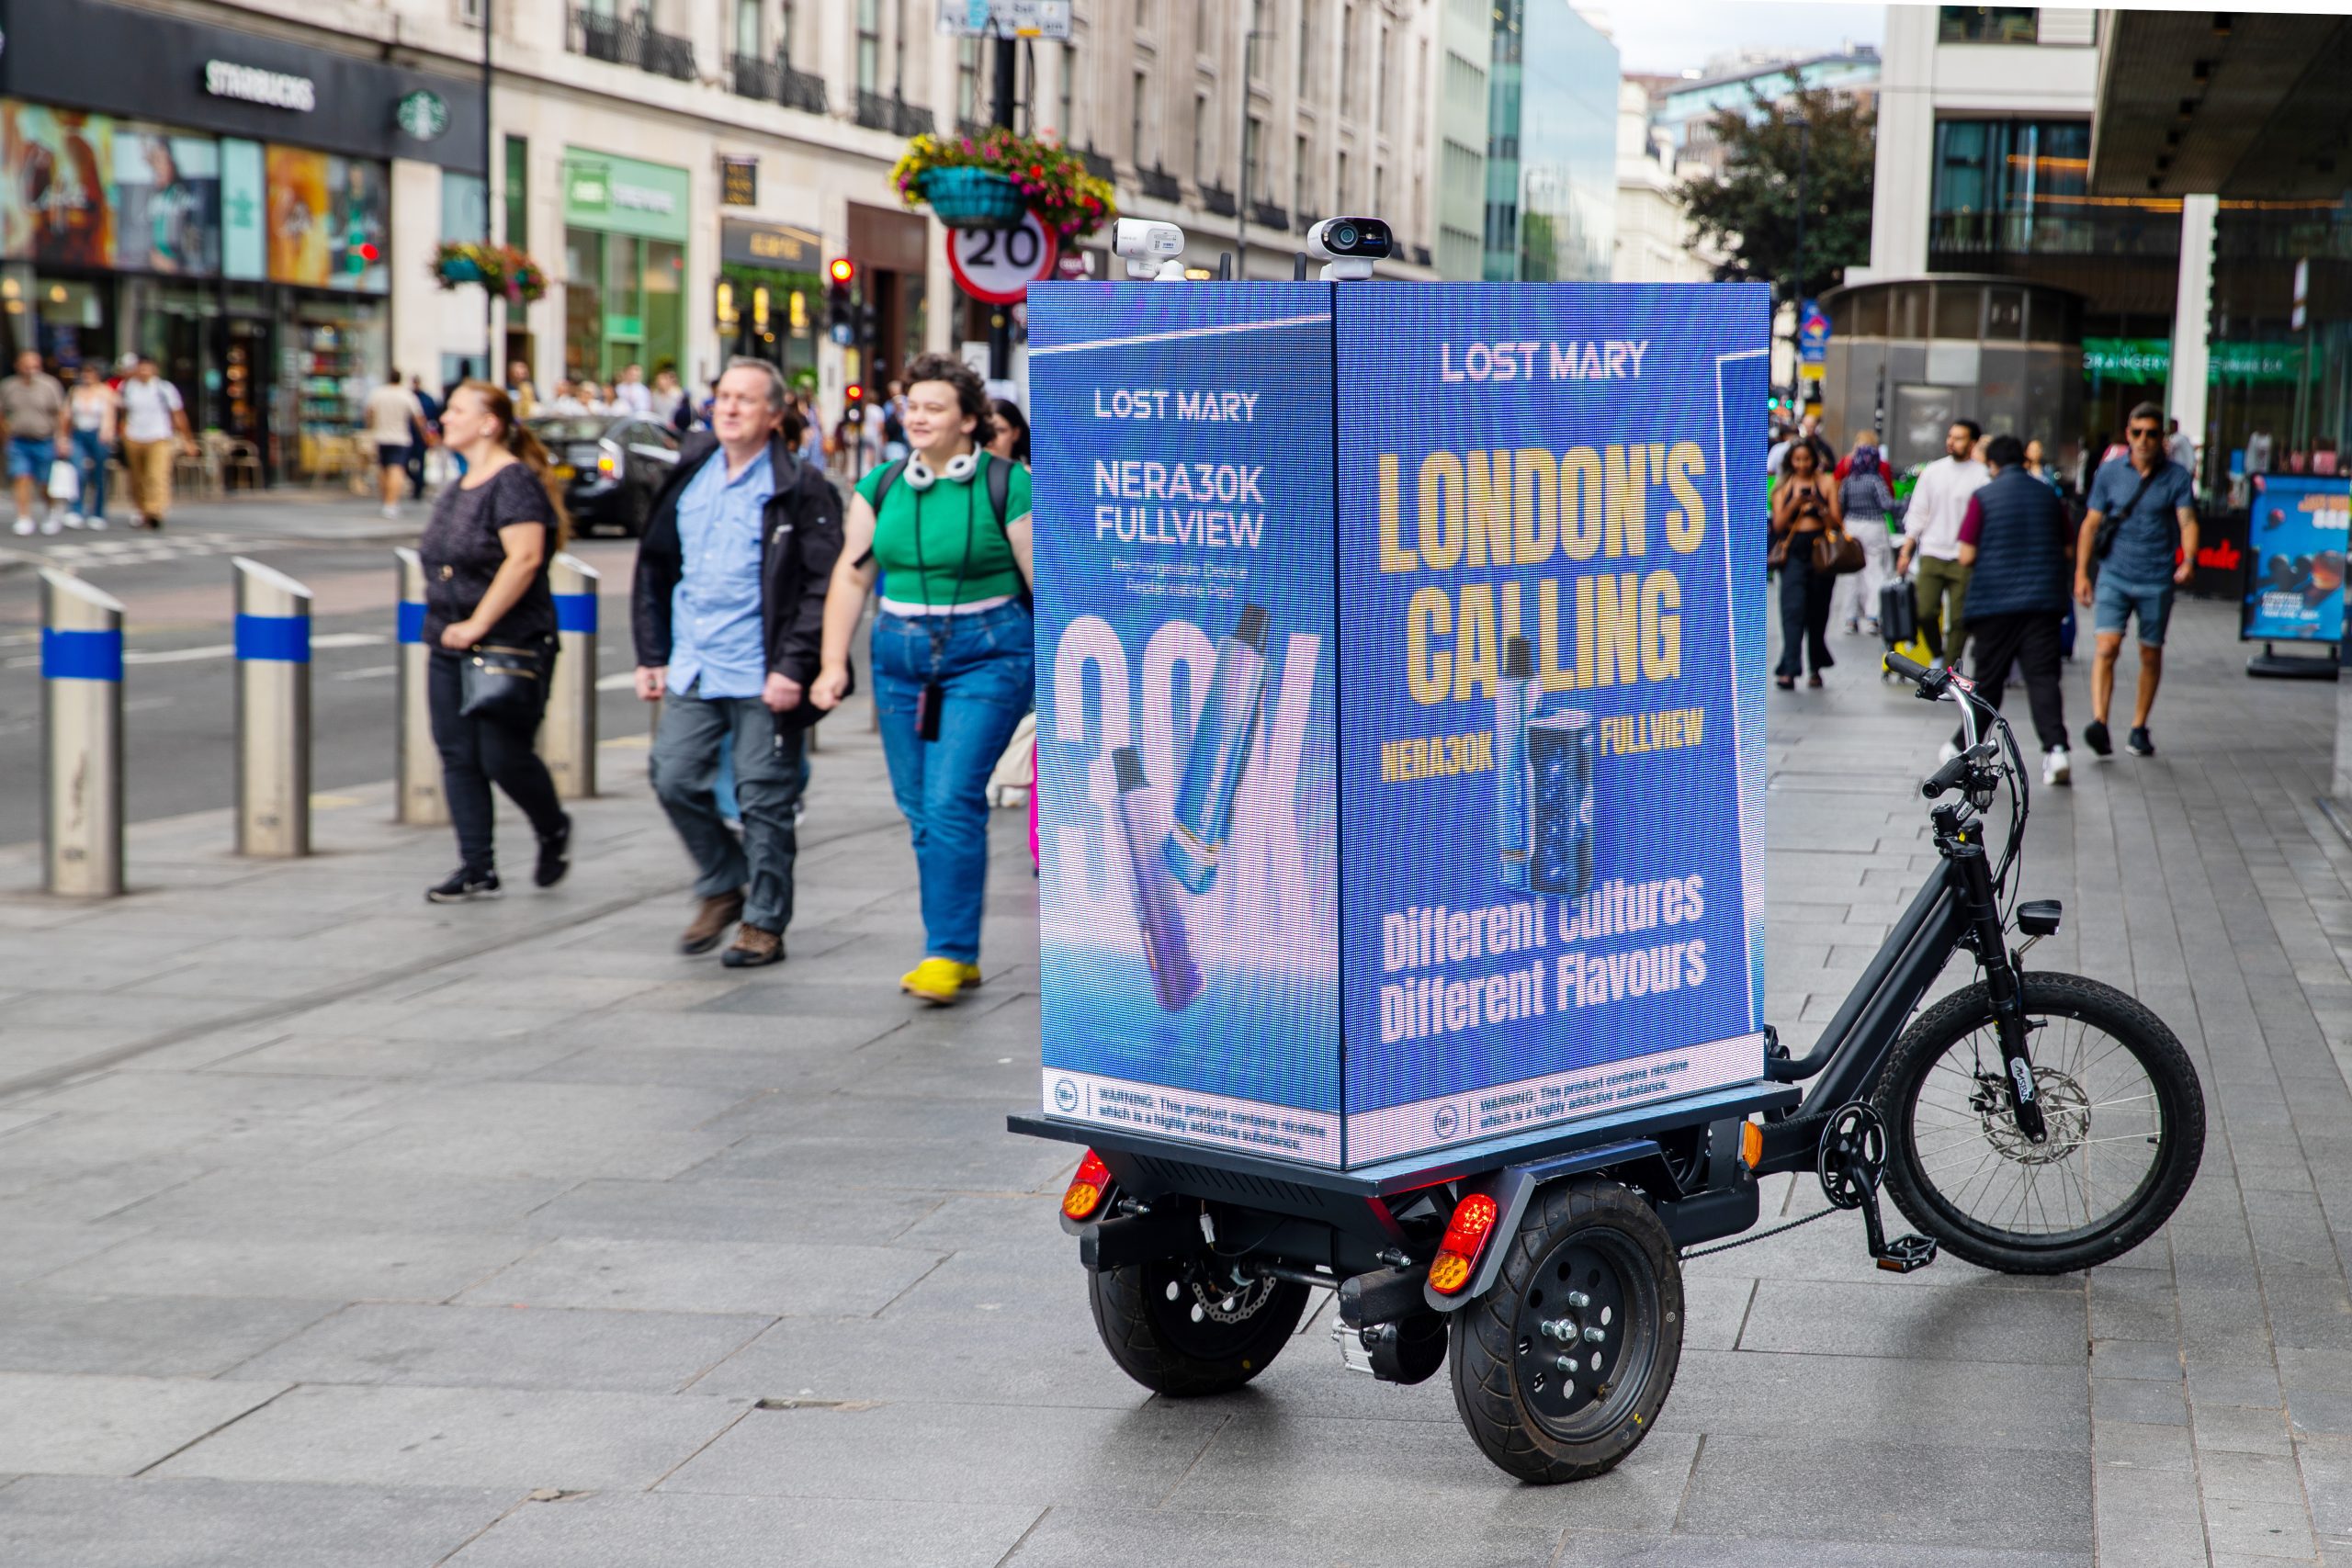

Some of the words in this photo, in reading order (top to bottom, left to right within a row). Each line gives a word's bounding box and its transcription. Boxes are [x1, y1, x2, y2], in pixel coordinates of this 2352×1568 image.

[966, 226, 1039, 267] 20
[1441, 341, 1541, 383] LOST
[1549, 340, 1649, 380] MARY
[1094, 388, 1170, 420] LOST
[1177, 389, 1260, 423] MARY
[1094, 459, 1264, 504] NERA30K
[1095, 505, 1265, 548] FULLVIEW
[1379, 440, 1707, 572] LONDON'S
[1600, 706, 1704, 756] FULLVIEW
[1381, 730, 1494, 784] NERA30K
[1383, 896, 1547, 973] Different
[1558, 873, 1705, 943] Cultures
[1381, 959, 1546, 1044] Different
[1556, 939, 1708, 1012] Flavours
